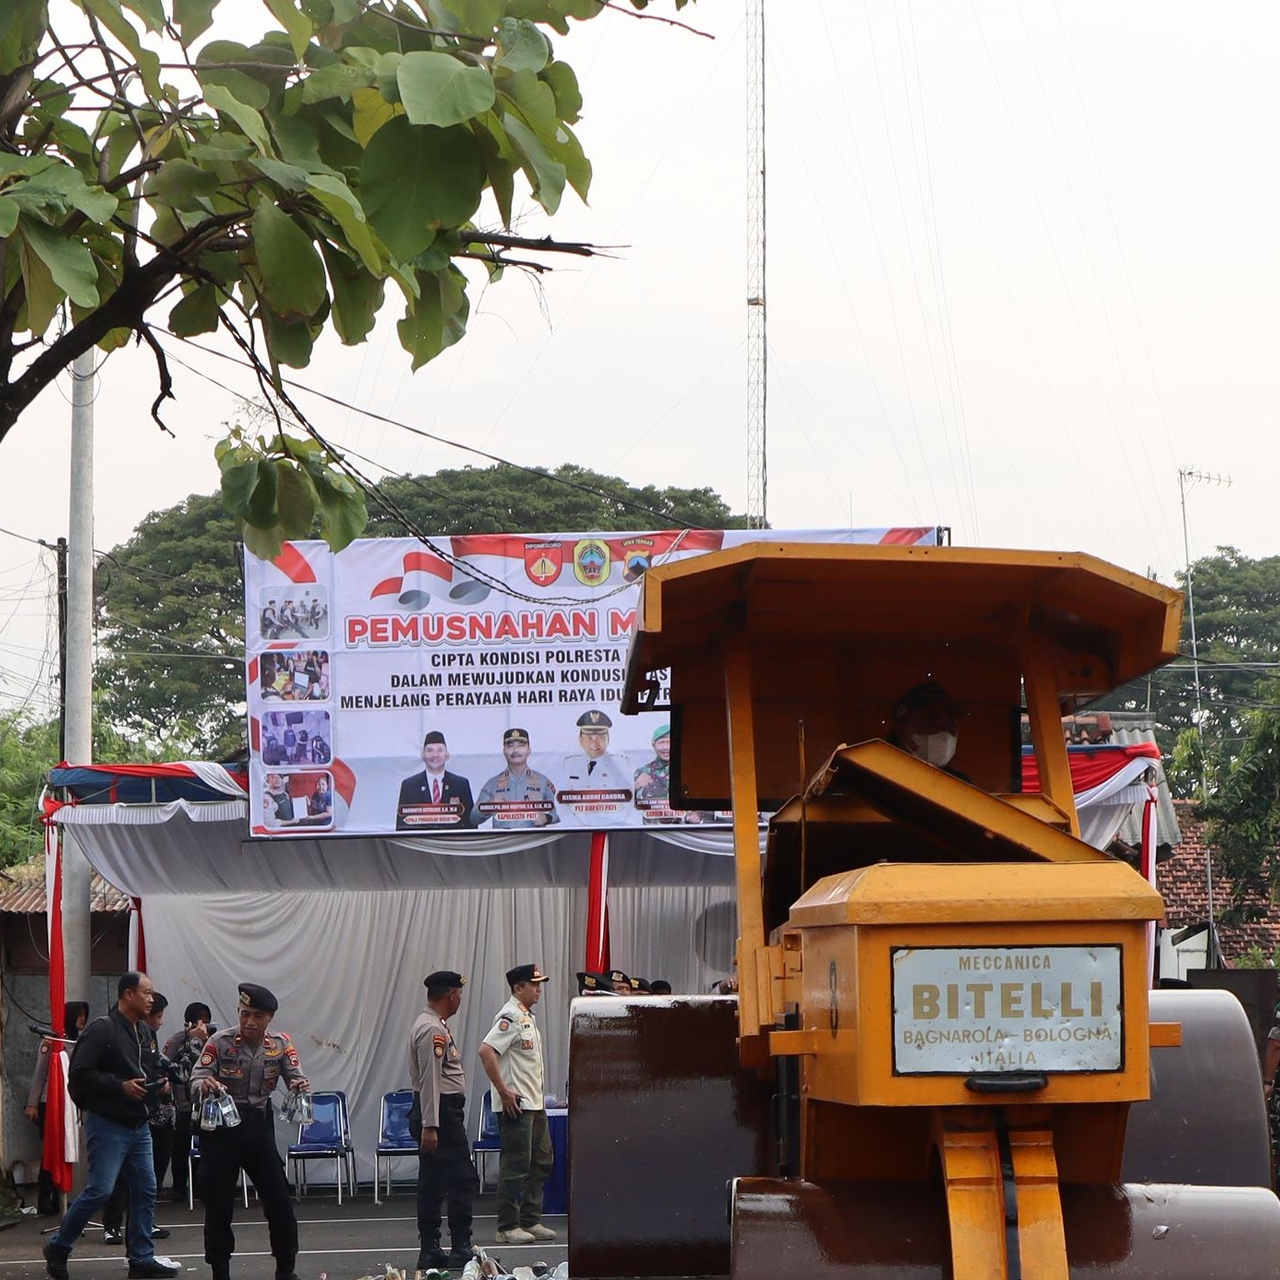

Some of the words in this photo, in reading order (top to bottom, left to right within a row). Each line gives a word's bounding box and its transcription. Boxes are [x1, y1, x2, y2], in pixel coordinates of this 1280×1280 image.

[347, 610, 597, 644] PEMUSNAHAN
[431, 653, 472, 668] CIPTA
[480, 651, 540, 667] KONDISI
[546, 649, 621, 665] POLRESTA
[391, 674, 443, 688] DALAM
[448, 671, 556, 686] MEWUJUDKAN
[341, 695, 430, 710] MENJELANG
[436, 692, 513, 707] PERAYAAN
[518, 690, 553, 704] HARI
[559, 689, 595, 703] RAYA
[600, 688, 625, 702] IDU
[958, 955, 1052, 971] MECCANICA
[912, 981, 1103, 1020] BITELLI
[903, 1028, 1005, 1045] BAGNAROLA
[1023, 1026, 1113, 1043] BOLOGNA
[979, 1051, 1037, 1065] ITALIA
